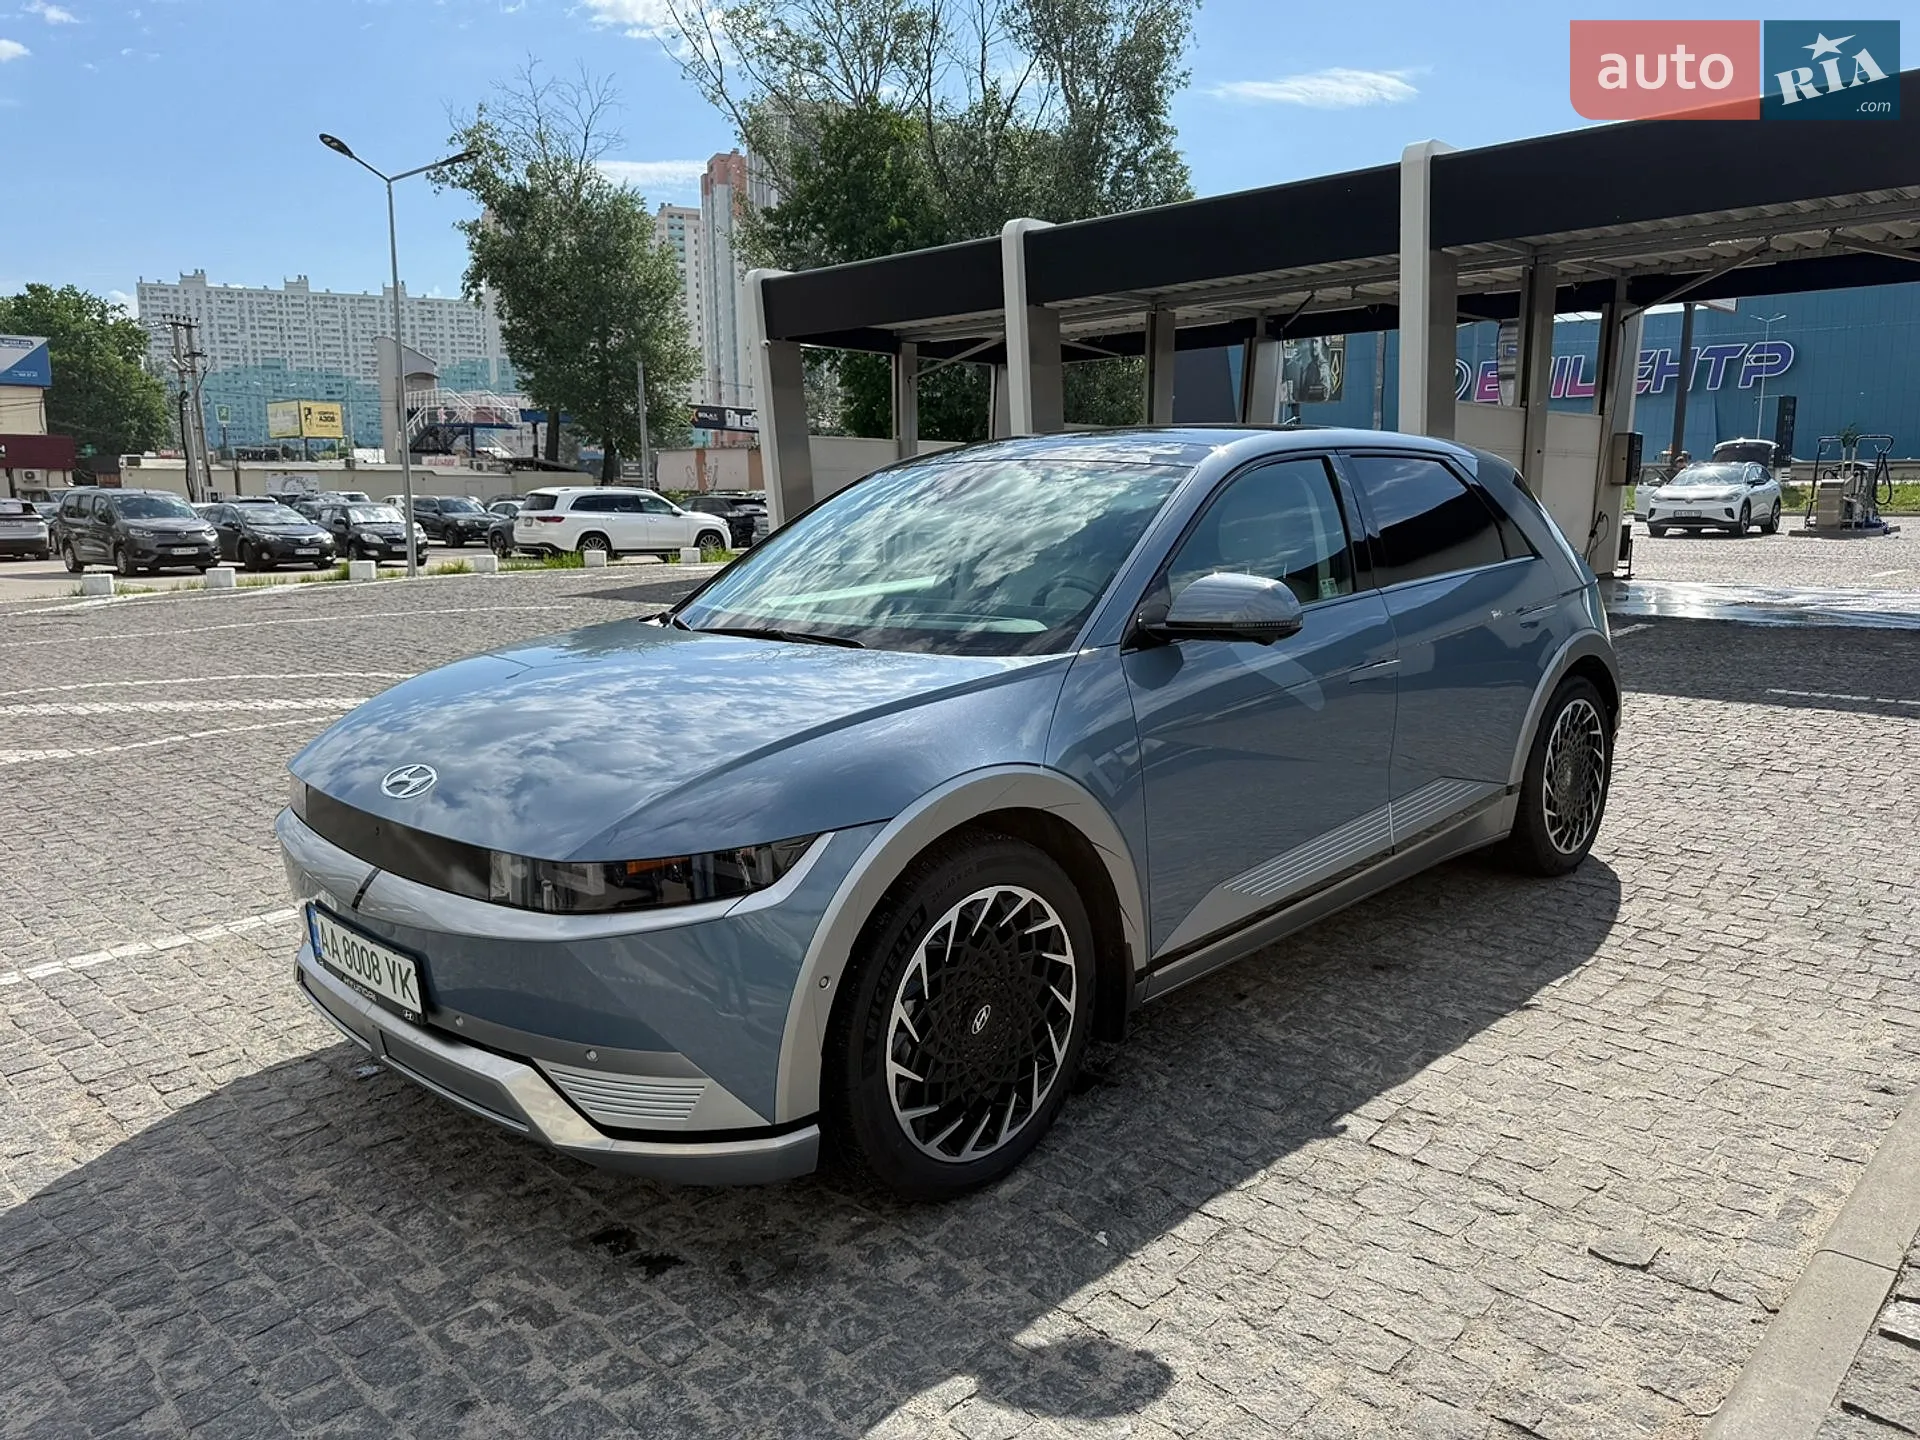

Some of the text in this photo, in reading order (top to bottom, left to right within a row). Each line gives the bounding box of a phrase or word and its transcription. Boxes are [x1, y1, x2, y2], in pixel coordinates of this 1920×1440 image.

[320, 920, 417, 1005] AA 8008 YK
[865, 907, 925, 1041] MICHELIN
